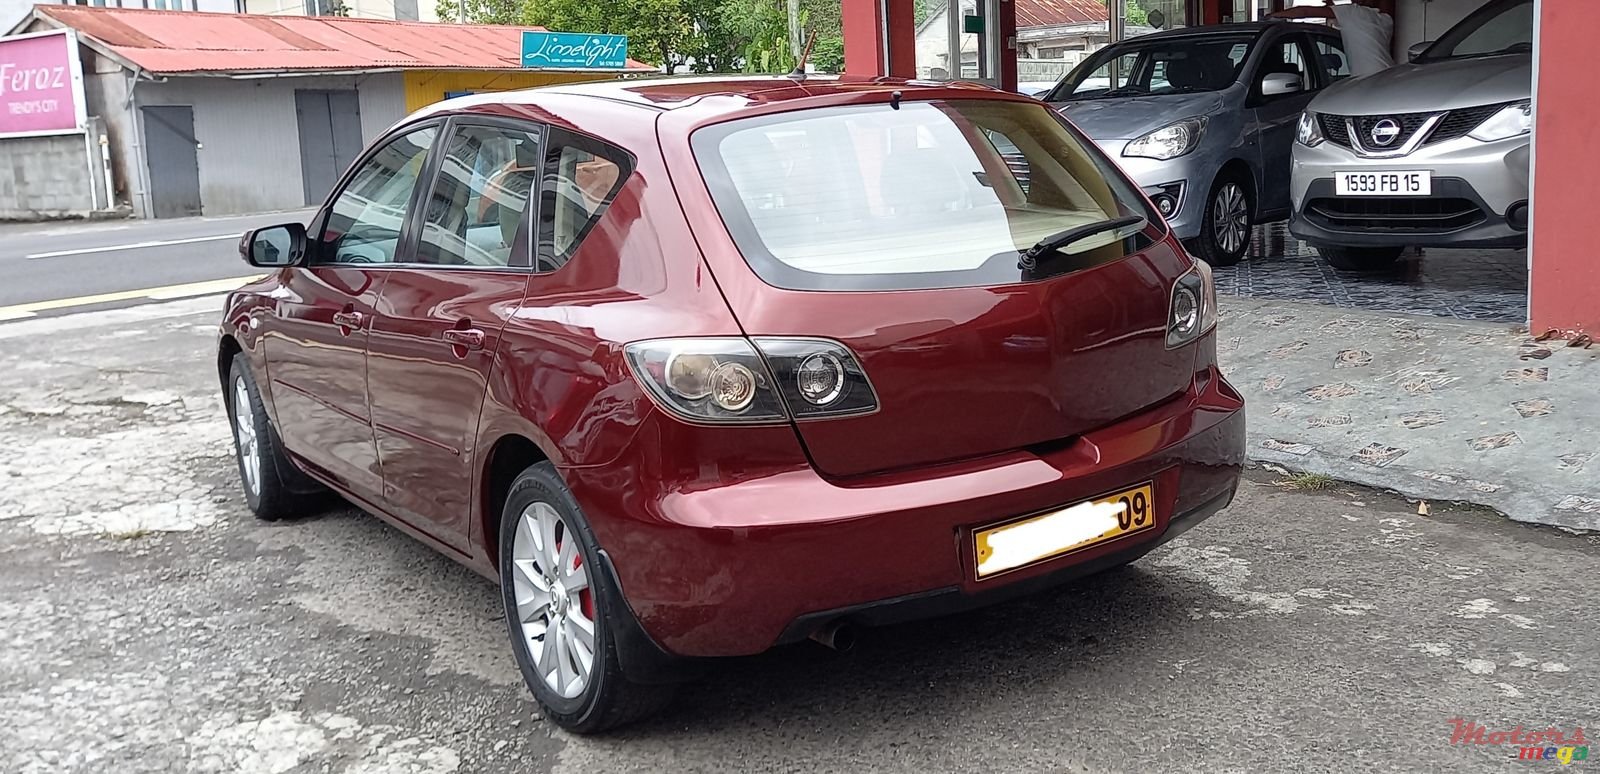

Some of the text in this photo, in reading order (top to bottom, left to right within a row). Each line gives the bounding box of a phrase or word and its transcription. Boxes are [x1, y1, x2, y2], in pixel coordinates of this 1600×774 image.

[525, 34, 625, 67] Limelight
[0, 63, 65, 97] Feroz
[1344, 174, 1420, 192] 1593 FB 15
[1117, 491, 1147, 531] 09
